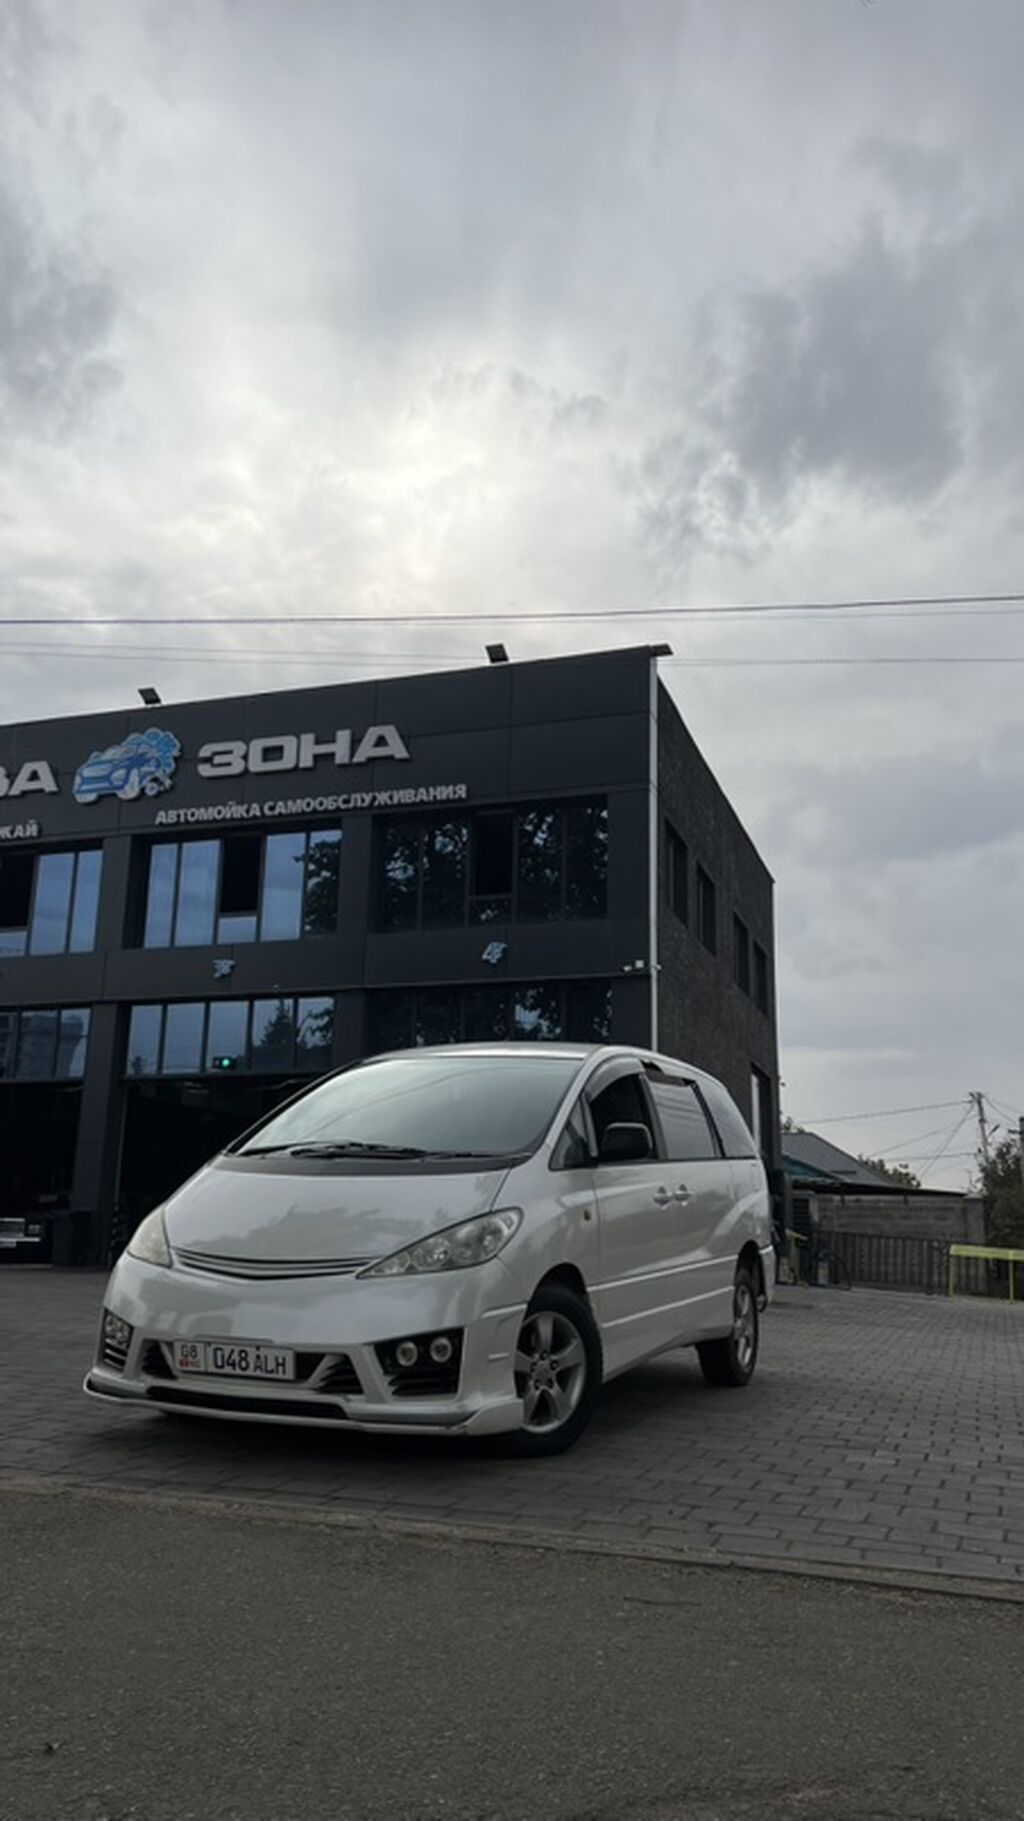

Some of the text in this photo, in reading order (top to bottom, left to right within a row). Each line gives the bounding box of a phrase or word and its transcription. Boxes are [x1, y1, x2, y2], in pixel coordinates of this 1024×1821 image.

[0, 724, 410, 797] А ЗОНА
[154, 783, 467, 826] АВТОМОЙКА САМООБСЛУЖИВАНИЯ
[213, 1346, 250, 1372] 048
[253, 1353, 286, 1375] ALH
